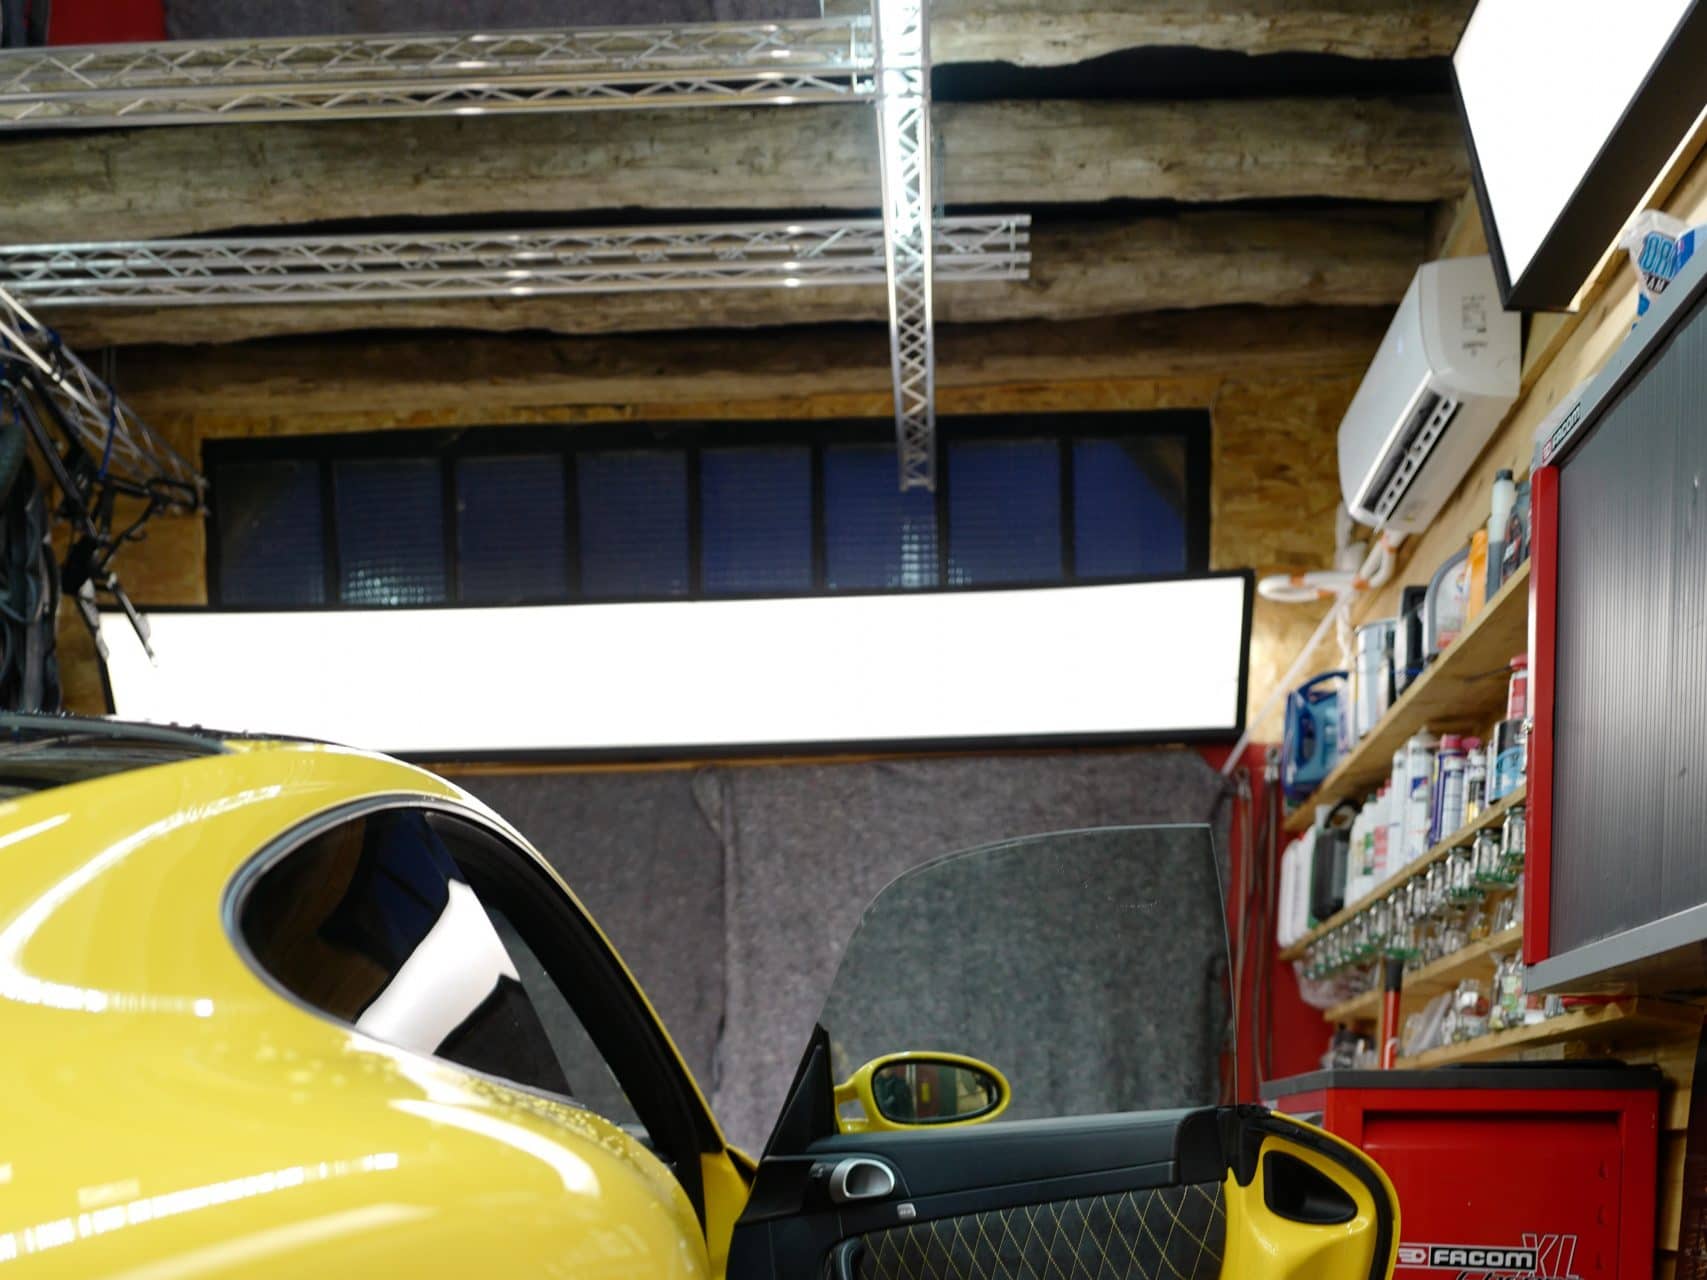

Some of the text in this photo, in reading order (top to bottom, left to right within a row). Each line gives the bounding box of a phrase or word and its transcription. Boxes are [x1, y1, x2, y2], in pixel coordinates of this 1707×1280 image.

[1553, 405, 1581, 448] FACOM
[1434, 1233, 1579, 1279] FACOM XL
